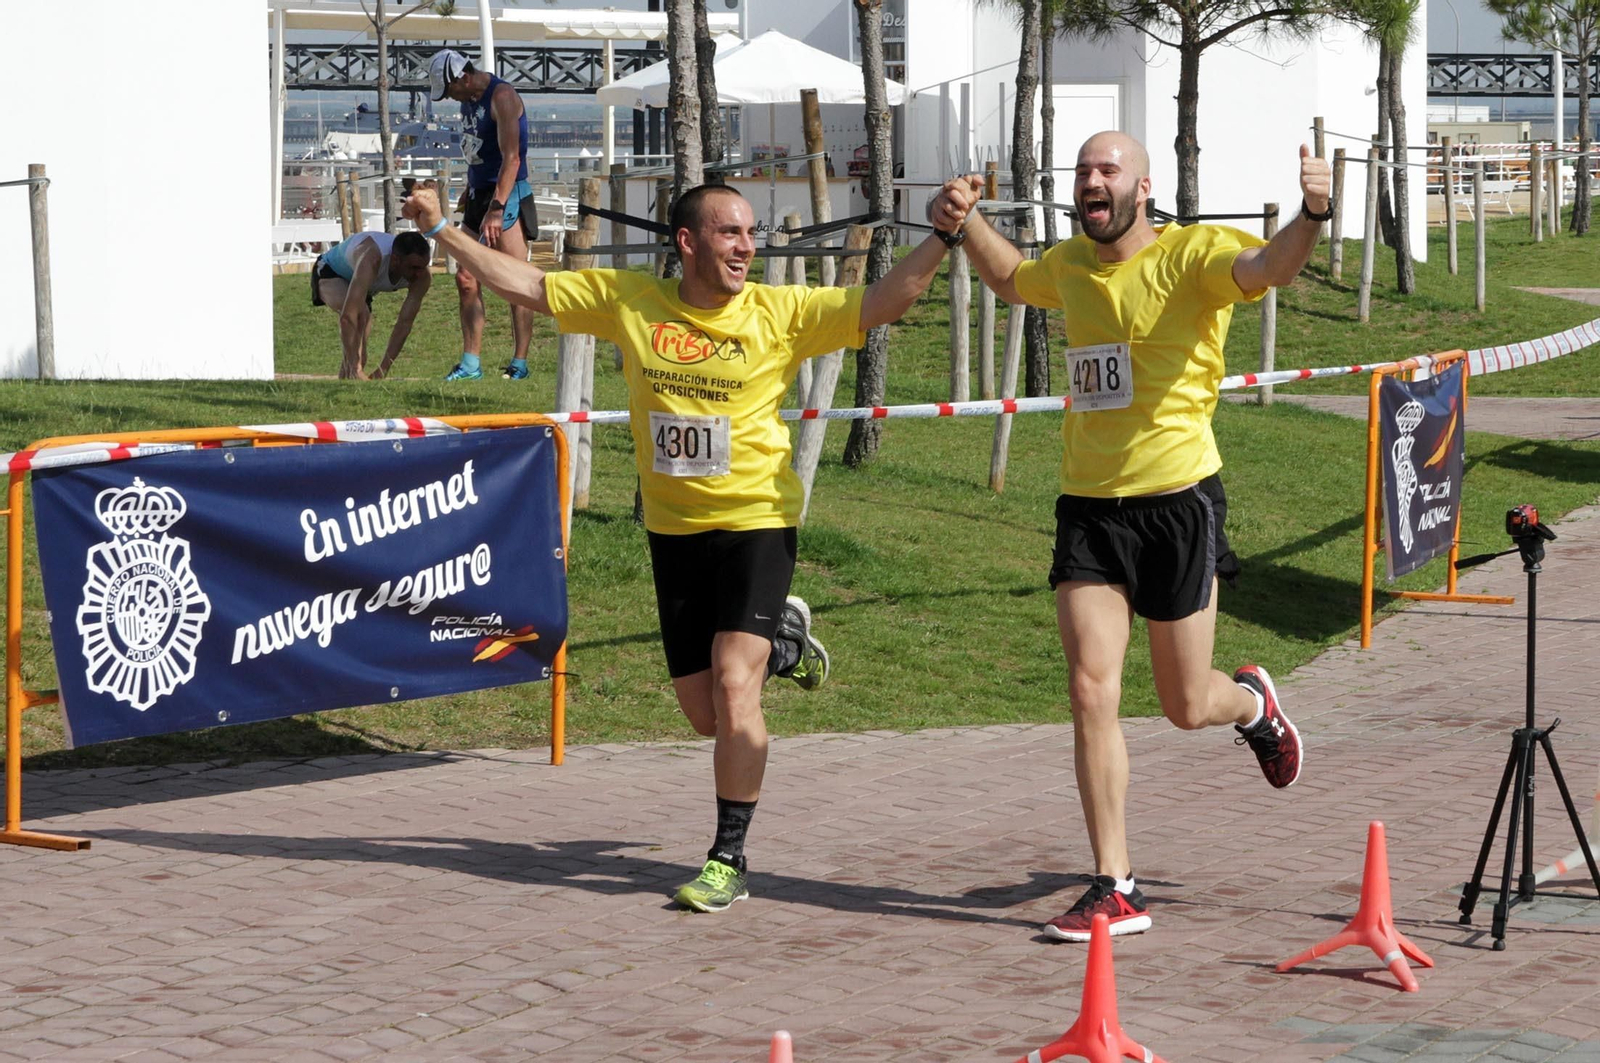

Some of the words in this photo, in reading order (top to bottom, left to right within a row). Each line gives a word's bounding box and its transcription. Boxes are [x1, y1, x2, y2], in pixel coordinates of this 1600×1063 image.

[642, 367, 708, 386] PREPARACIÓN
[710, 377, 743, 390] FÍSICA
[653, 382, 729, 402] OPOSICIONES
[1073, 356, 1120, 394] 4218
[656, 424, 712, 459] 4301
[299, 508, 347, 563] En
[345, 459, 479, 546] internet
[106, 571, 130, 624] CUERPO
[132, 562, 177, 596] NACIONAL
[172, 596, 183, 615] DE
[231, 587, 363, 665] navega
[364, 543, 492, 615] segur@
[429, 627, 516, 643] NACIONAL
[431, 612, 503, 626] POLICÍA
